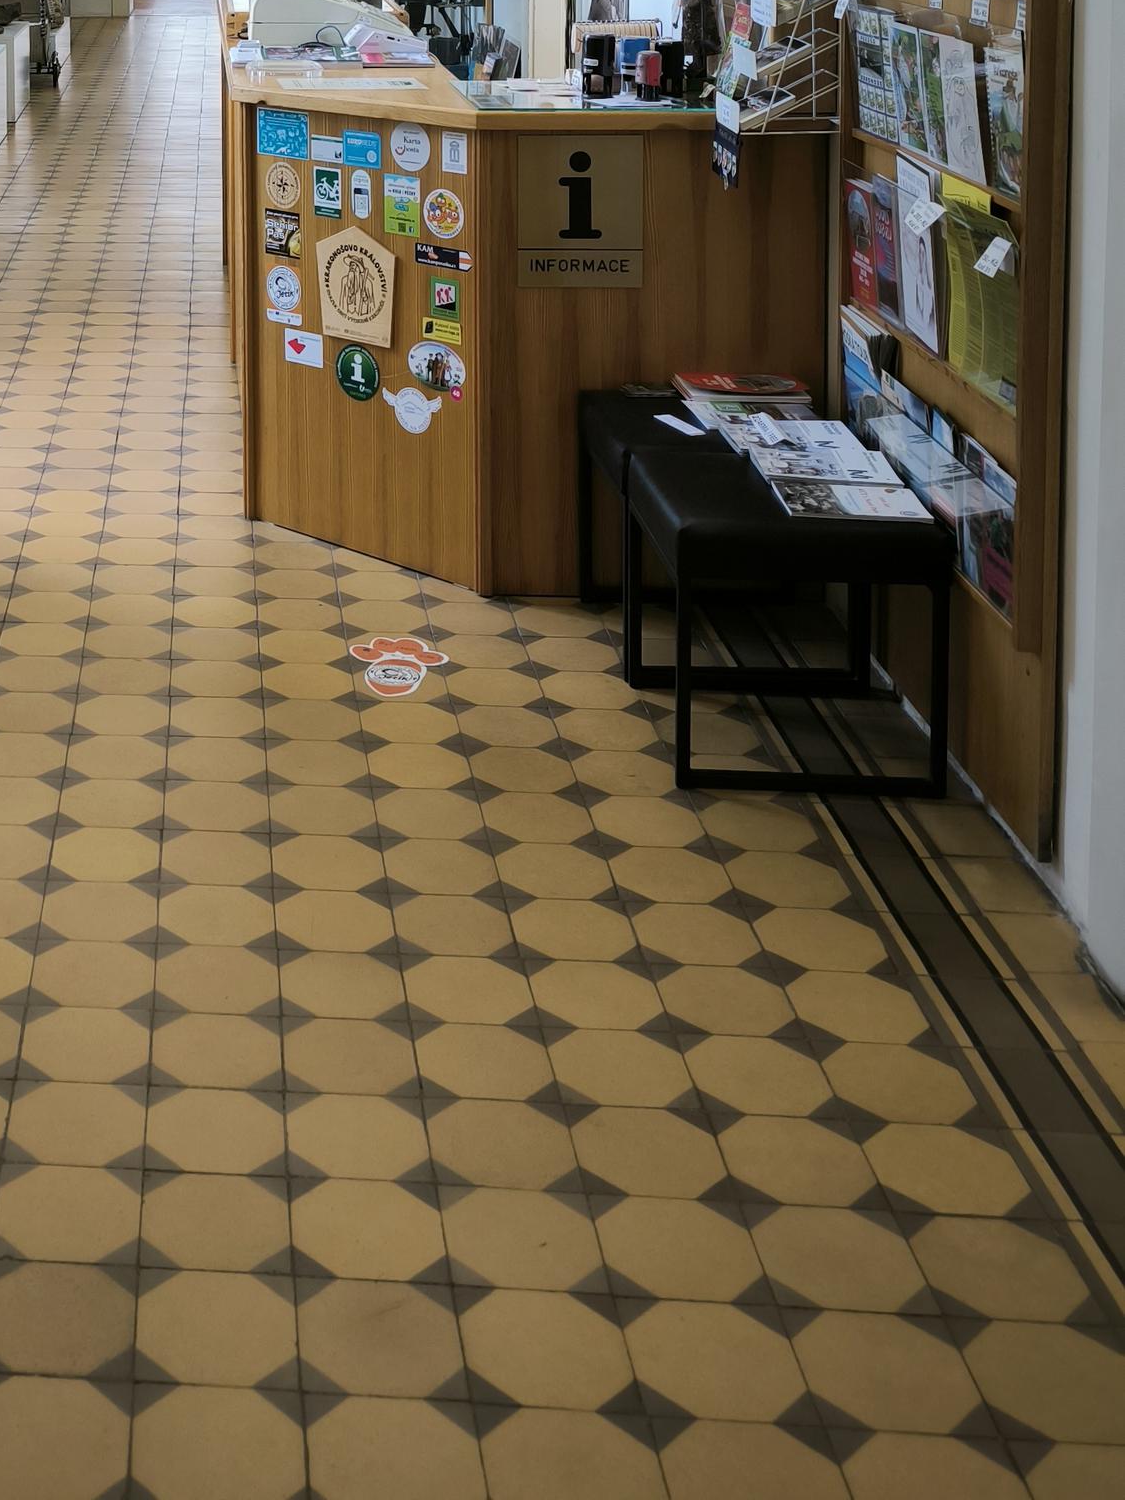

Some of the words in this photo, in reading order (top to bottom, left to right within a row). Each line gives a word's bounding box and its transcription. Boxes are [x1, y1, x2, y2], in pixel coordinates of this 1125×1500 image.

[266, 218, 299, 232] Senior
[266, 228, 285, 240] Pas
[416, 244, 434, 253] KAM
[325, 244, 358, 283] KRAKONOŠOVO
[359, 247, 389, 293] KRÁLOVSTVÍ
[529, 258, 630, 274] INFORMACE
